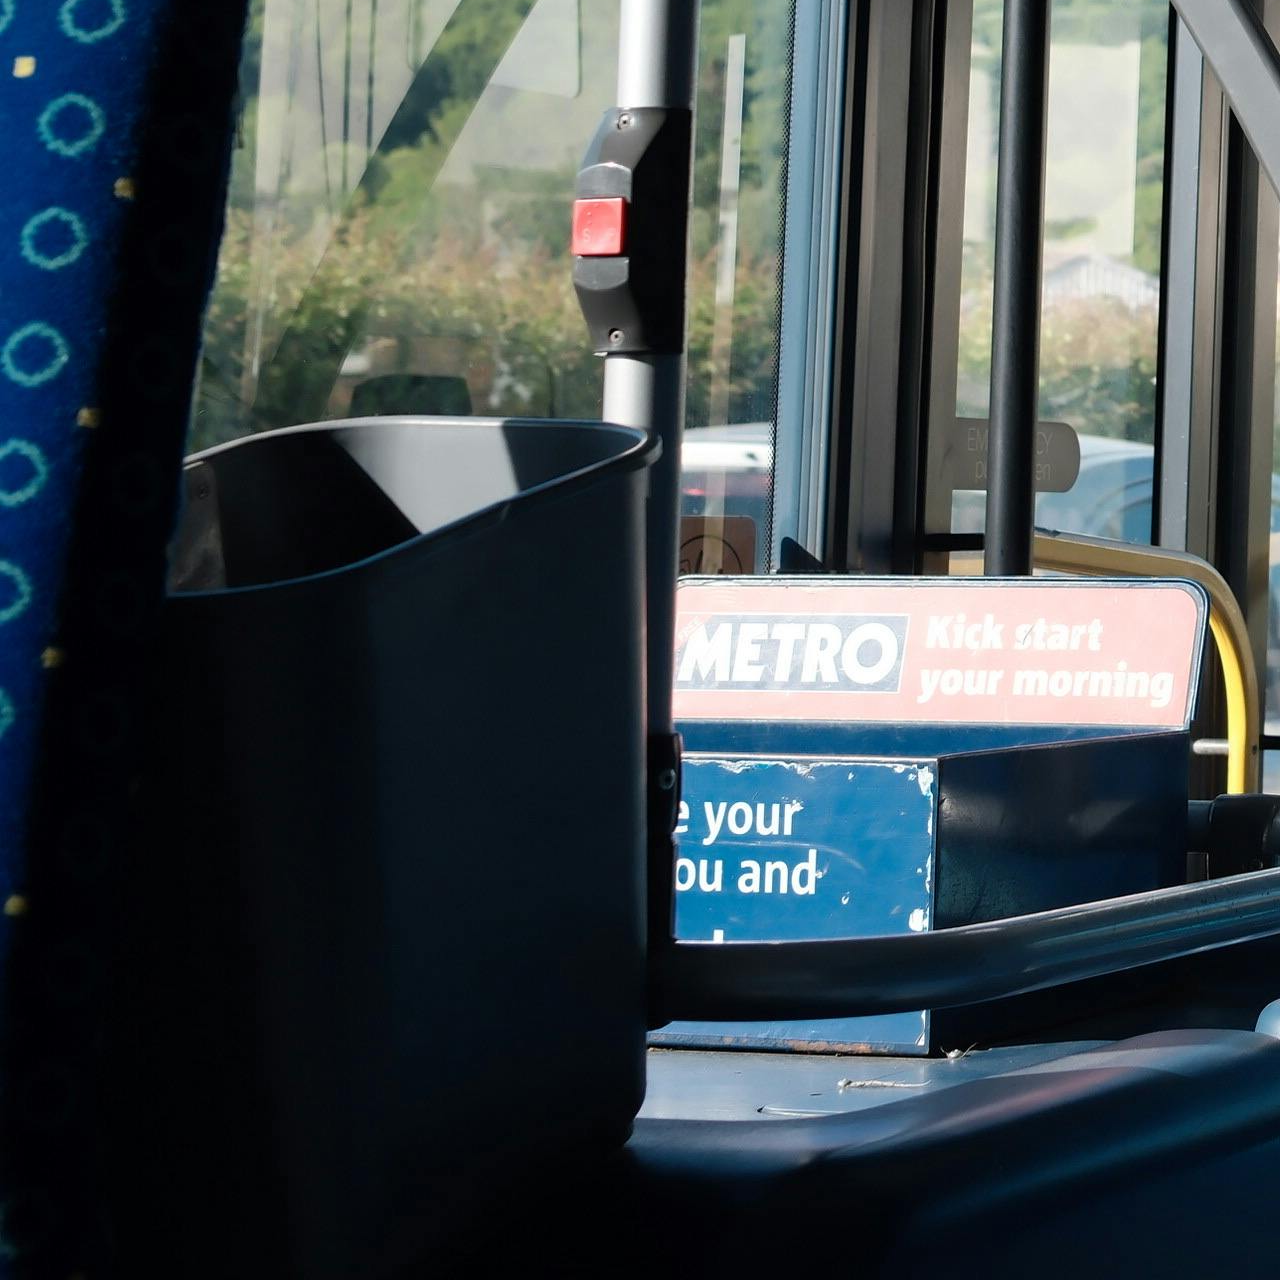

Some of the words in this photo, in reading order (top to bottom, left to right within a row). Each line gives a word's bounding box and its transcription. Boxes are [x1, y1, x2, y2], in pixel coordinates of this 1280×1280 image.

[677, 621, 900, 686] METRO
[925, 614, 1004, 651] Kick
[1014, 618, 1104, 652] start
[917, 667, 1004, 704] your
[1013, 661, 1174, 708] morning
[702, 800, 804, 846] your
[674, 858, 723, 892] ou
[737, 848, 817, 895] and
